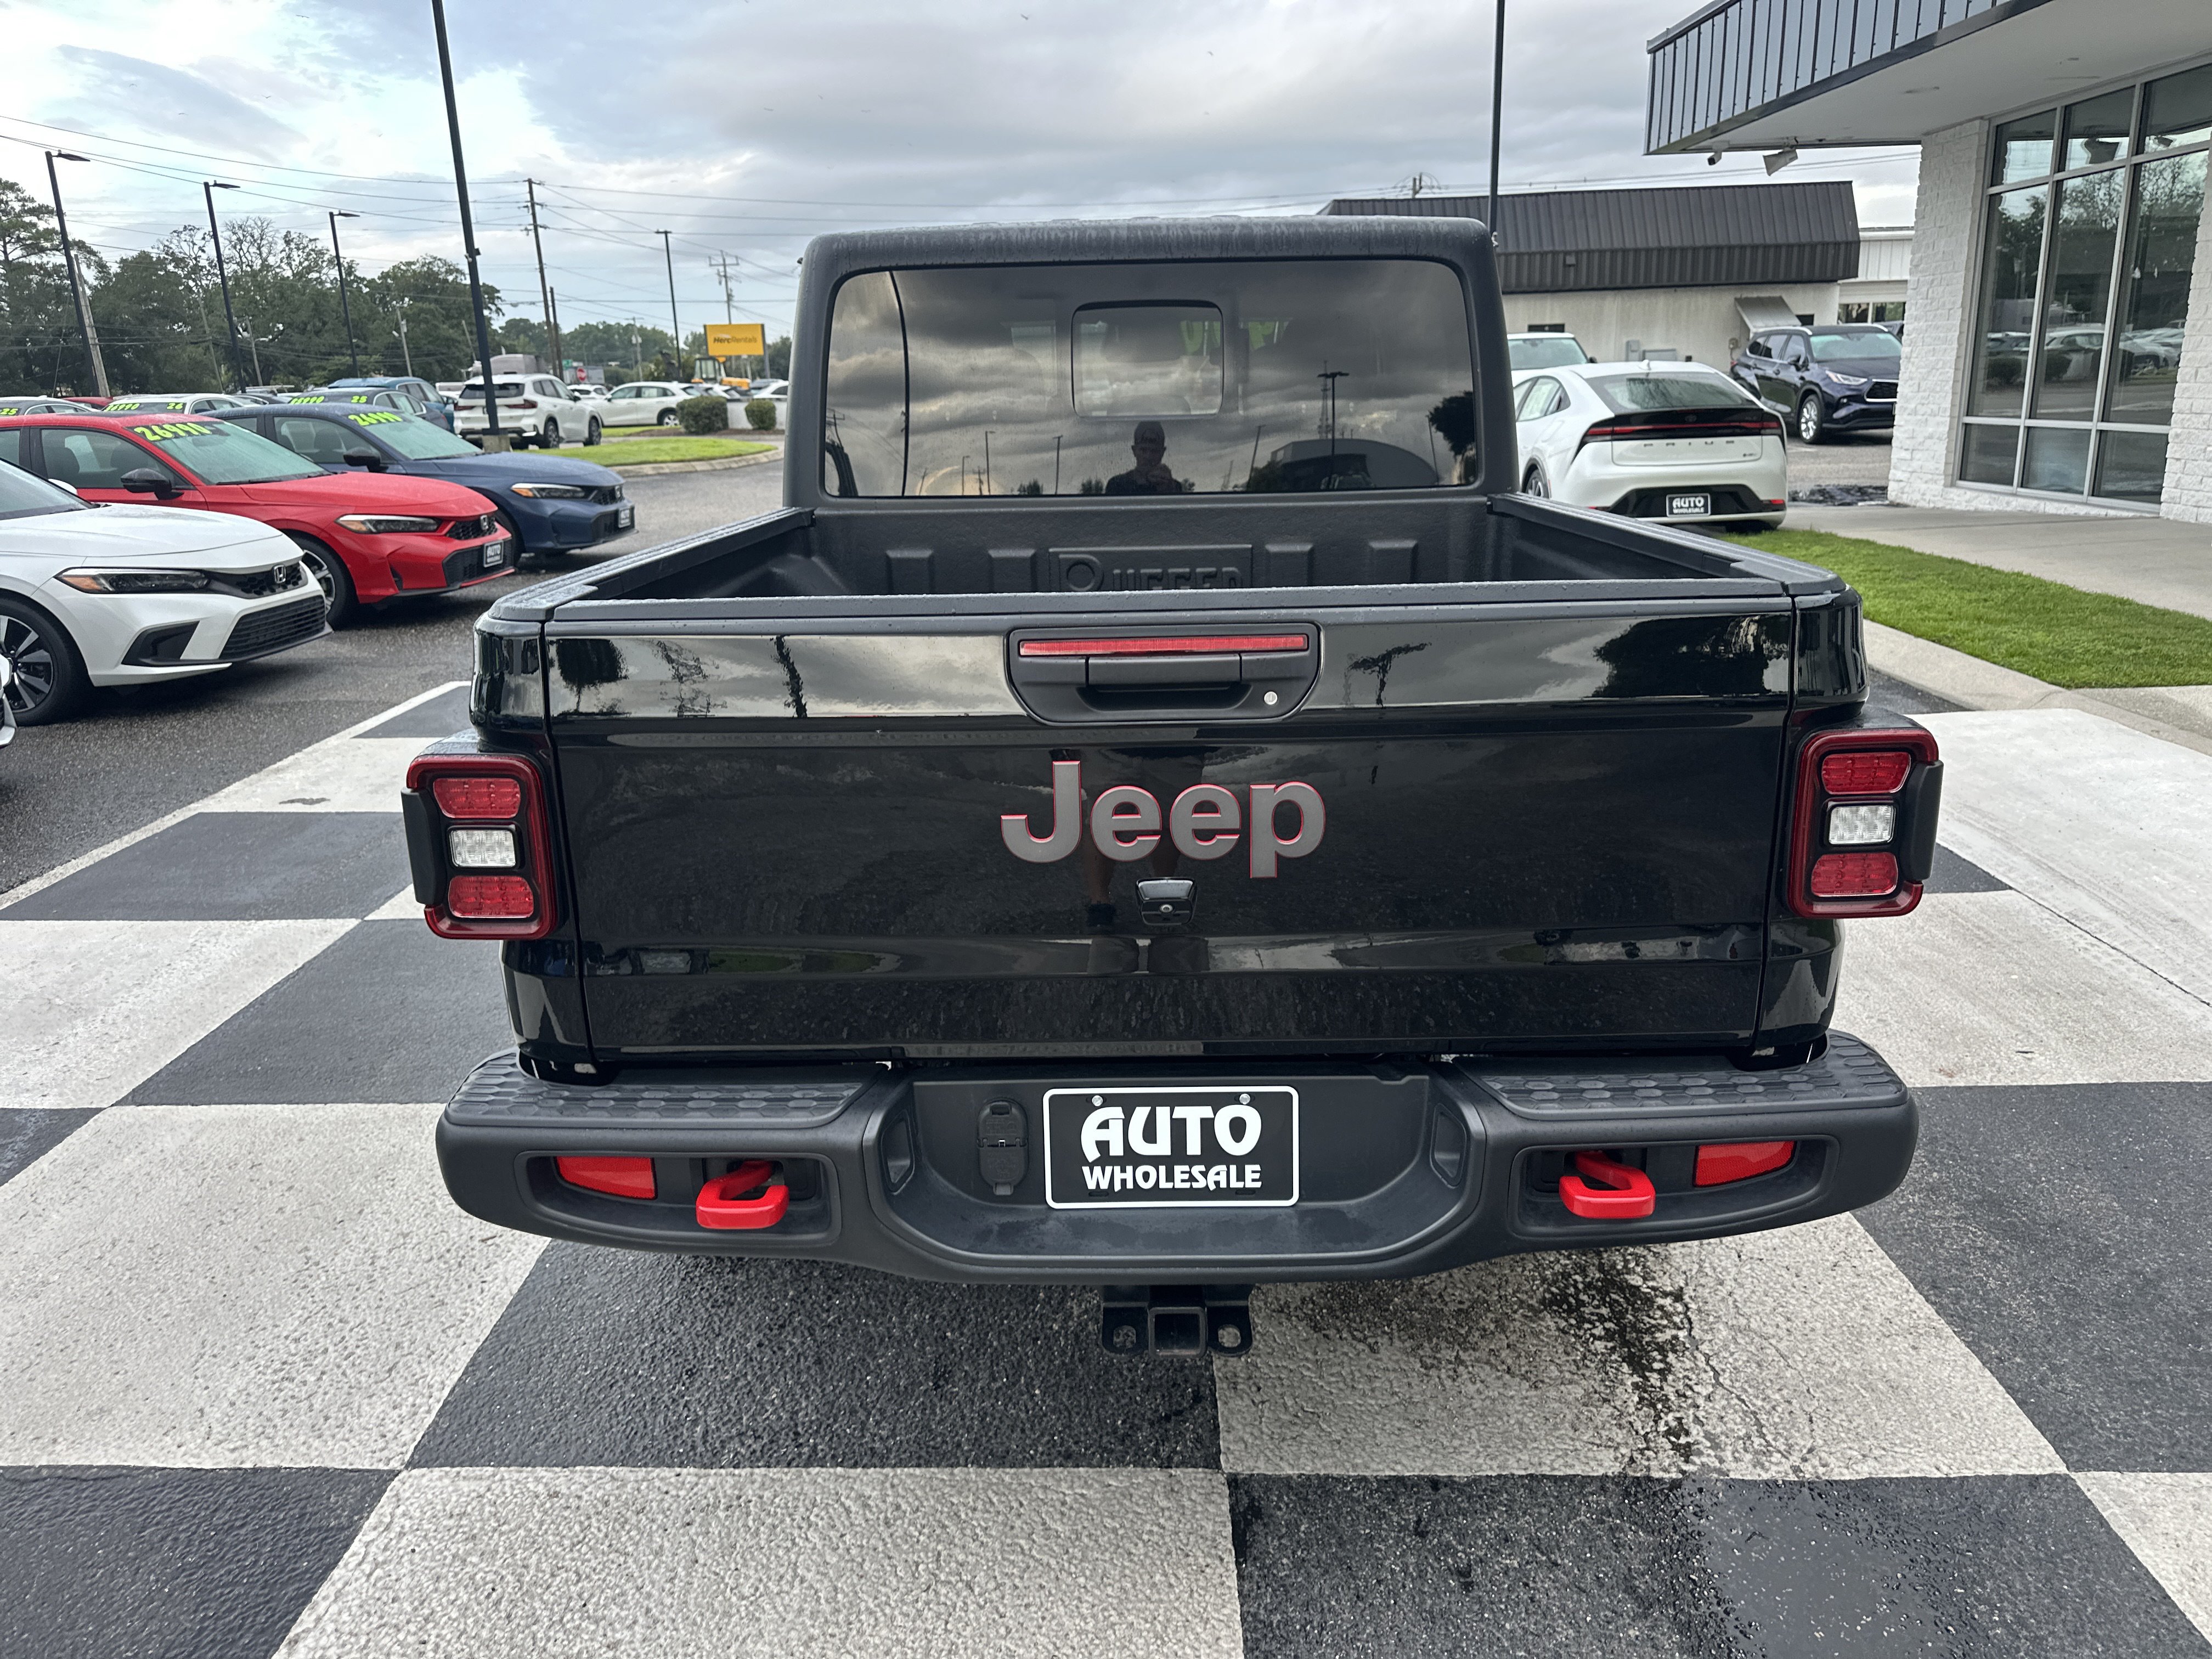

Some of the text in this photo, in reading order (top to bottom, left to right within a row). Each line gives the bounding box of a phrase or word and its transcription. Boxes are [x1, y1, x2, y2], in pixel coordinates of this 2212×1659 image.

[134, 422, 211, 441] 26990
[1672, 496, 1705, 509] AUTO
[1001, 760, 1326, 878] Jeep
[1080, 1104, 1262, 1163] AUTO
[1081, 1164, 1262, 1192] WHOLESALE
